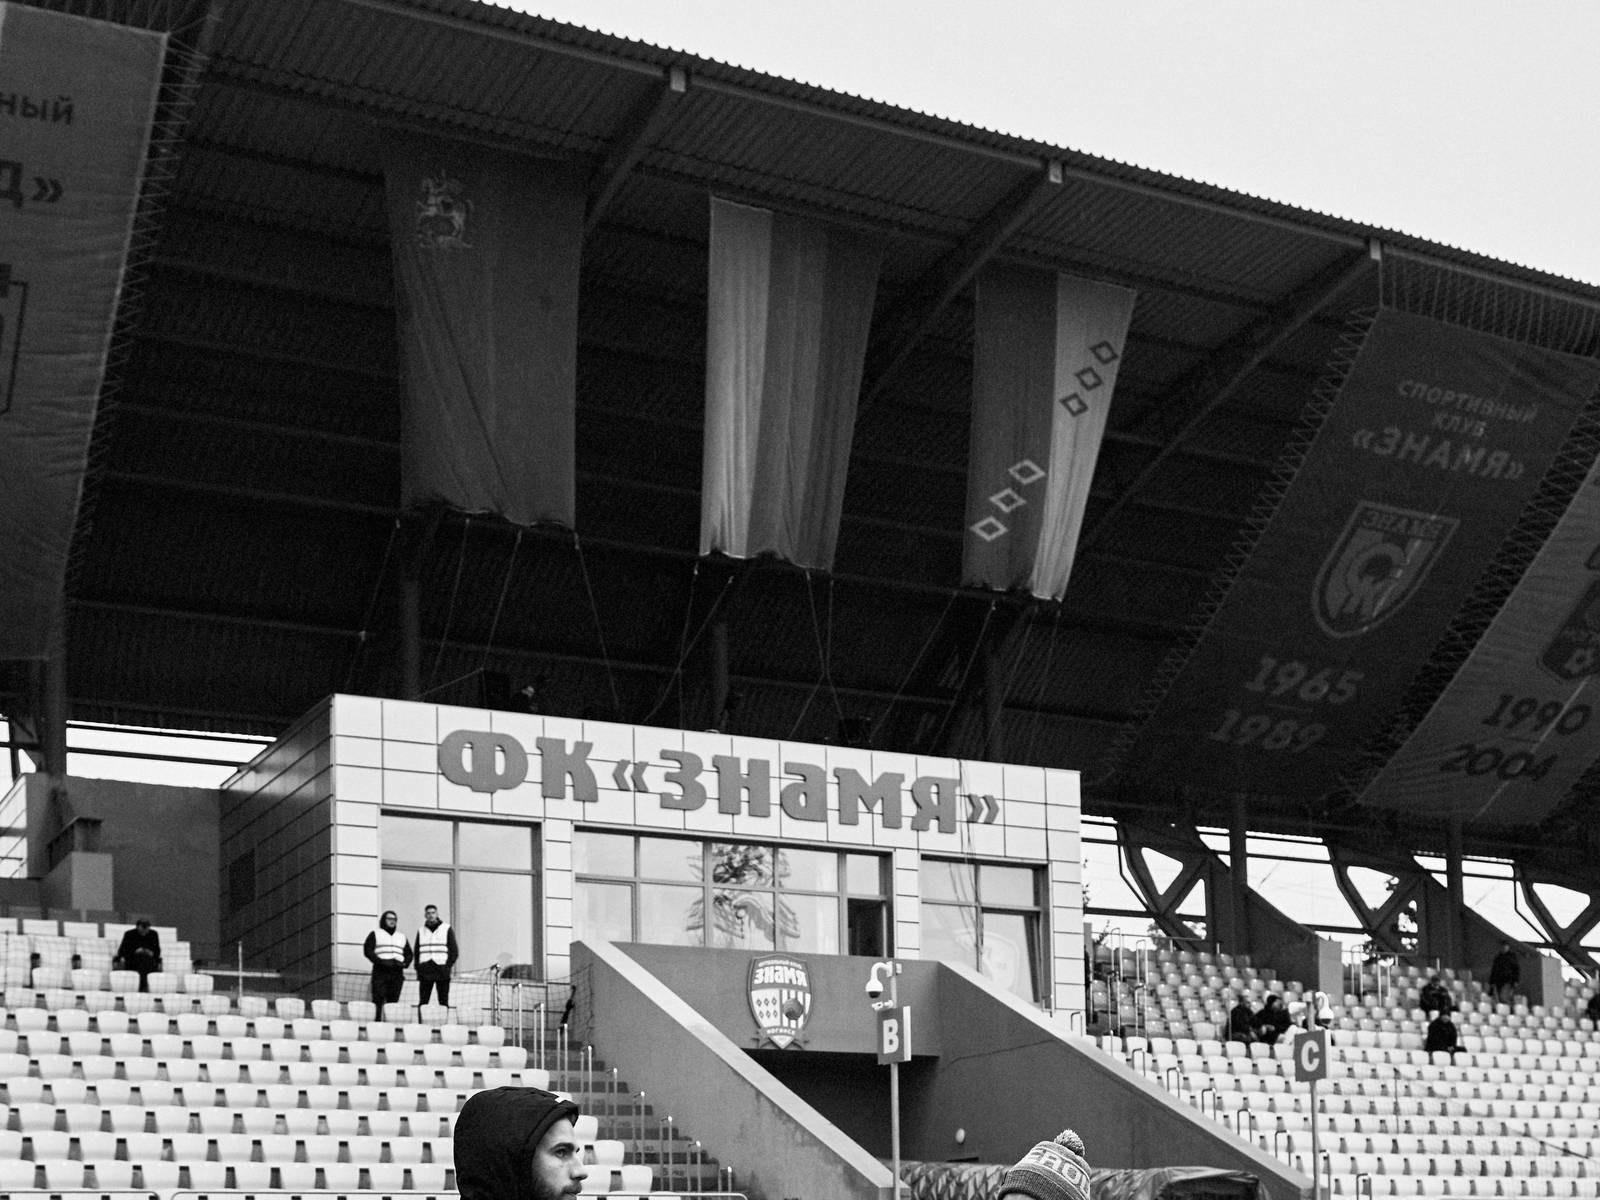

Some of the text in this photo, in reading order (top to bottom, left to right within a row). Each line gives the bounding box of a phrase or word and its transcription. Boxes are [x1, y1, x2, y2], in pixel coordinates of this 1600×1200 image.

[1353, 426, 1525, 480] «ЗНАМЯ»
[1243, 654, 1366, 705] 1965
[1480, 693, 1593, 736] 1990
[438, 729, 598, 802] ФК
[1439, 741, 1559, 782] 2004
[883, 1018, 900, 1055] B
[1301, 1040, 1320, 1072] C
